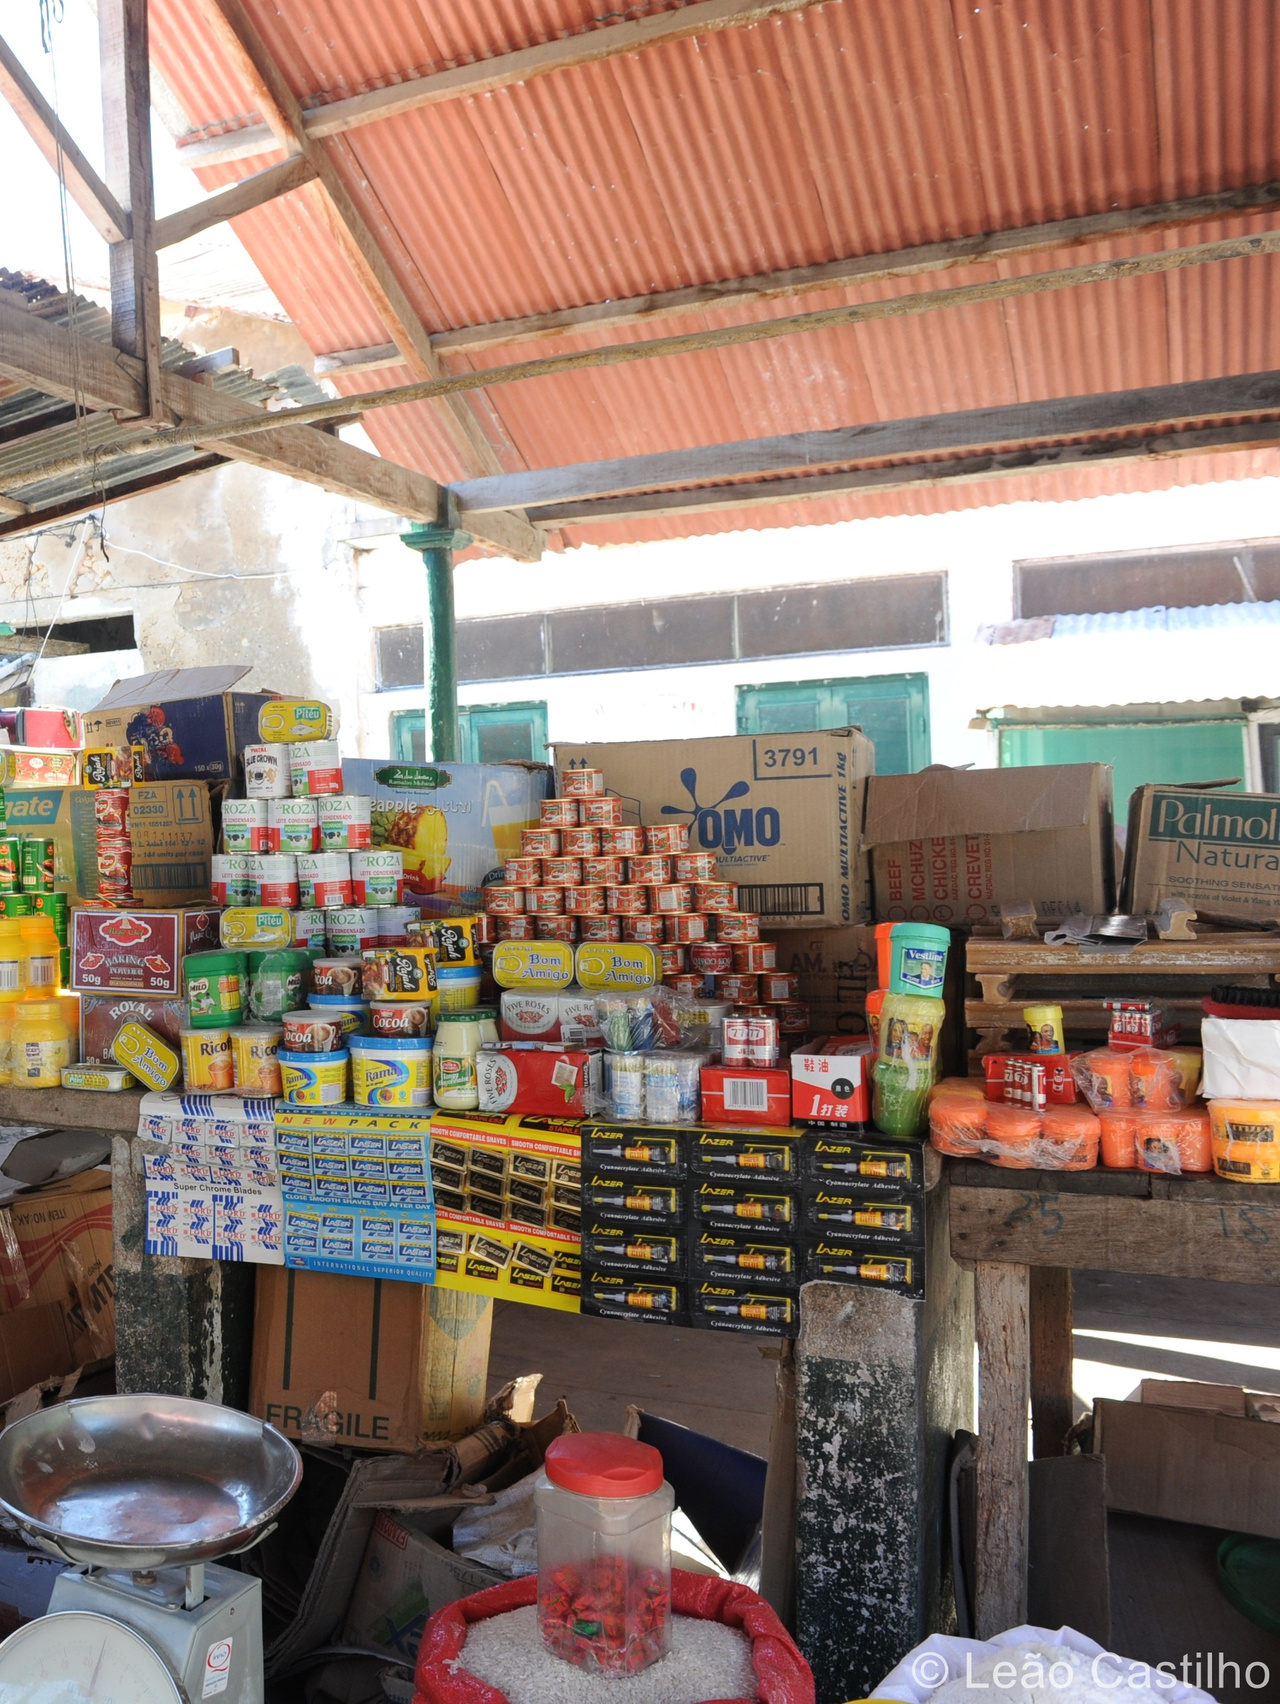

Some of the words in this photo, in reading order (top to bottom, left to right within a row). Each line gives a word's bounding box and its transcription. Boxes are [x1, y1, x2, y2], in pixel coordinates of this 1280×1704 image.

[257, 755, 278, 767] CROWN
[764, 747, 818, 768] 3791
[836, 752, 847, 778] 1kg
[138, 790, 157, 800] FZA
[133, 804, 164, 815] 02330
[224, 804, 256, 814] ROZA
[282, 804, 316, 815] ROZA
[370, 797, 418, 814] eapple
[1158, 799, 1280, 840] Palmol
[698, 807, 780, 850] OMO
[837, 784, 849, 880] MULTIACTIVE
[367, 856, 401, 867] ROZA
[965, 834, 982, 899] CREVET
[910, 840, 926, 901] MCHUZ
[932, 836, 948, 900] CHICKE
[488, 870, 505, 881] Drin
[889, 860, 903, 901] BEEF
[1168, 876, 1229, 888] SOOTHING
[841, 884, 850, 922] OMO
[330, 914, 365, 925] ROZA
[105, 954, 145, 968] BAKING
[529, 954, 561, 965] Bom
[611, 957, 643, 969] Bom
[109, 968, 144, 976] POWDER
[396, 957, 415, 990] Rajah
[522, 968, 570, 981] Amigo
[604, 970, 652, 985] Amigo
[82, 974, 101, 986] 50g
[150, 977, 170, 989] 50g
[190, 983, 207, 992] MILO
[109, 1001, 155, 1021] ROYAL
[506, 1001, 524, 1013] FIVE
[525, 1000, 551, 1015] ROSES
[564, 1004, 581, 1016] FIVE
[373, 1015, 409, 1029] Cocoa
[144, 1046, 168, 1072] Bom
[132, 1055, 167, 1087] Amigo
[804, 1058, 829, 1073] 鞋油
[366, 1066, 398, 1082] Rama
[484, 1059, 497, 1086] ROSES
[485, 1087, 497, 1105] FIVE
[282, 1117, 337, 1126] NEW
[348, 1119, 421, 1129] PACK
[465, 1114, 503, 1124] STAINLESS
[181, 1126, 201, 1134] LORD
[591, 1128, 623, 1140] LAZER
[449, 1130, 485, 1142] COMFORTABLE
[486, 1135, 506, 1145] SHAVES
[699, 1134, 734, 1146] LAZER
[354, 1139, 382, 1149] LASER
[391, 1141, 420, 1150] LASER
[511, 1140, 533, 1149] SMOOTH
[534, 1143, 572, 1156] COMFORTABLE
[815, 1141, 852, 1153] LAZER
[600, 1163, 639, 1173] Cyanoacrylate
[641, 1166, 666, 1174] Adhesive
[173, 1183, 197, 1191] Super
[199, 1185, 231, 1193] Chrome
[234, 1187, 262, 1195] Blades
[825, 1179, 869, 1190] Cyanoacrylate
[872, 1182, 900, 1190] Adhesive
[342, 1198, 371, 1206] SHAVES
[190, 1208, 212, 1216] LORD
[365, 1221, 392, 1231] LASER
[402, 1247, 430, 1257] LASER
[478, 1239, 506, 1259] LASER
[313, 1260, 370, 1272] INTERNATIONAL
[373, 1266, 404, 1275] SUPERIOR
[406, 1269, 433, 1278] QUALITY
[468, 1260, 497, 1273] LASER
[266, 1402, 390, 1441] FRAGILE
